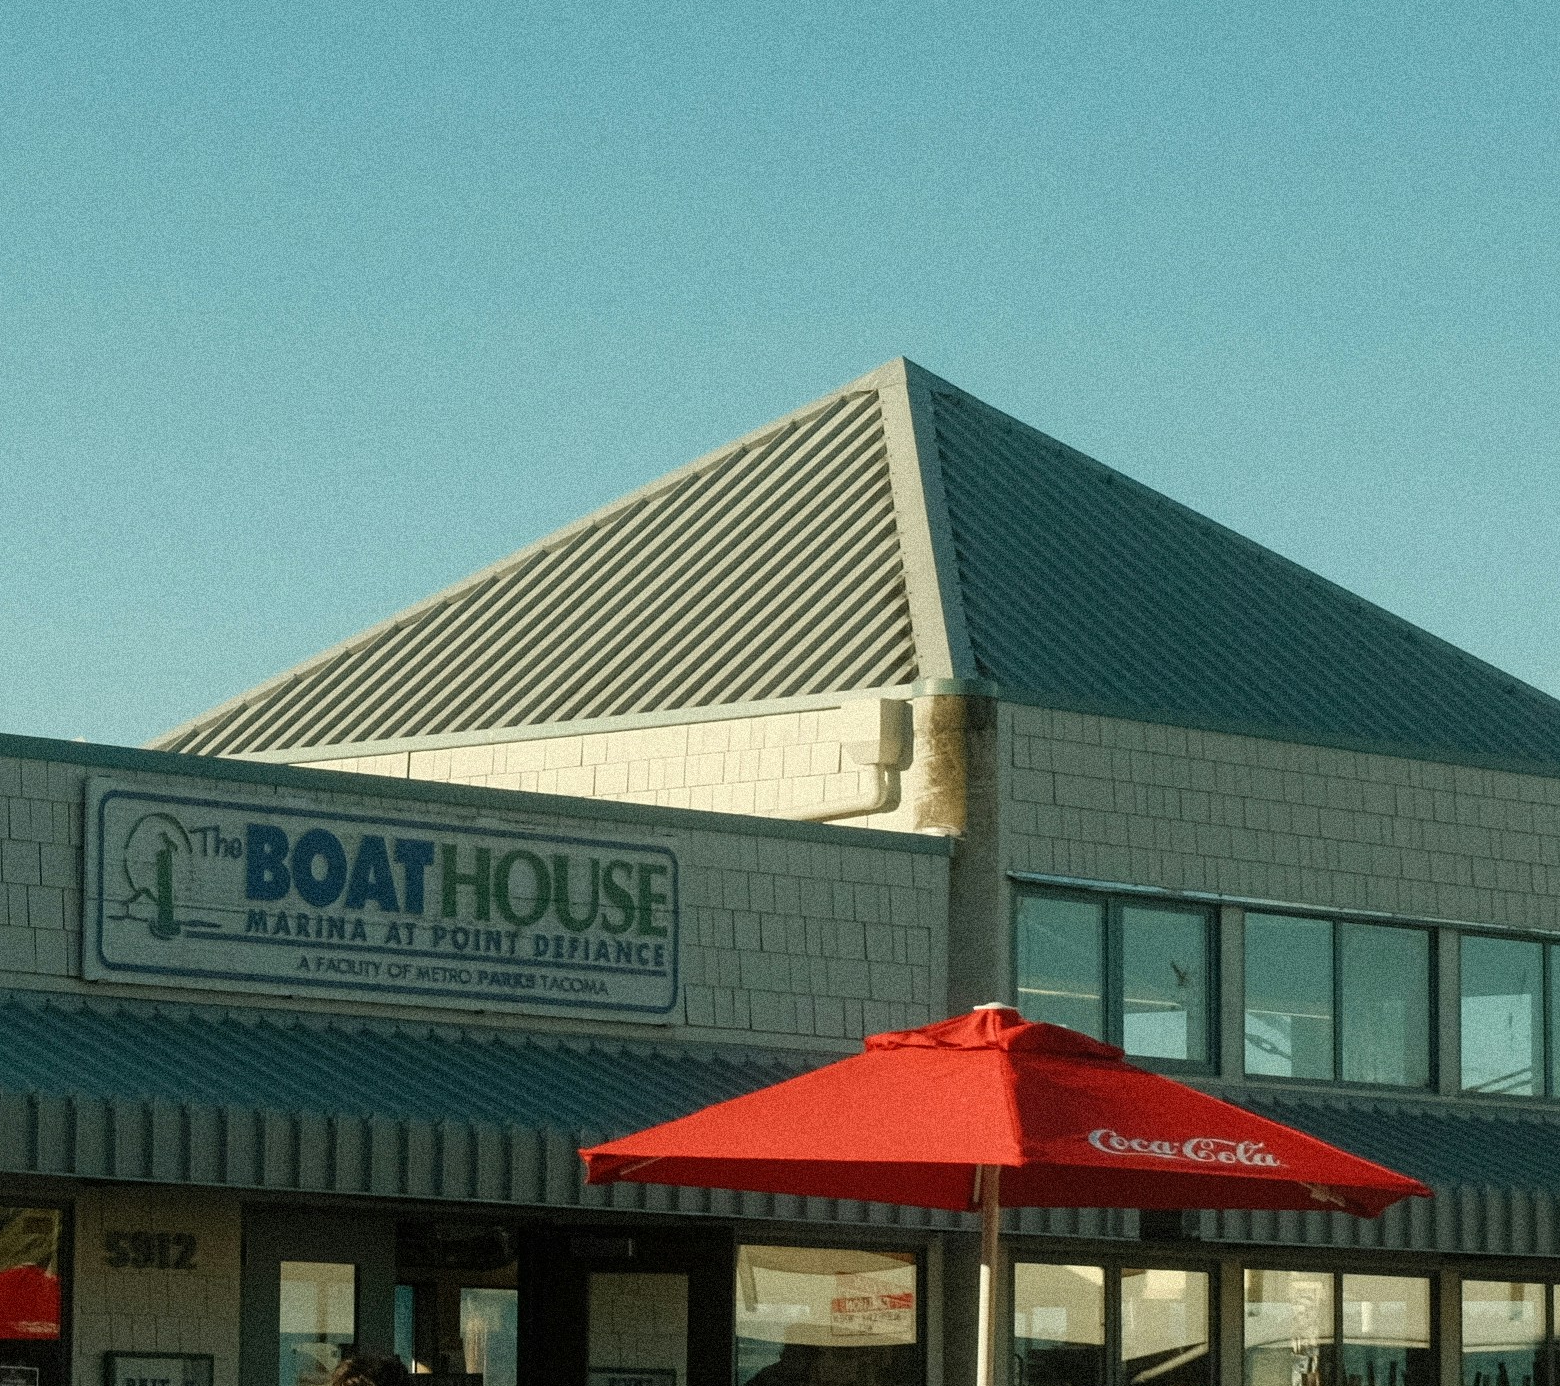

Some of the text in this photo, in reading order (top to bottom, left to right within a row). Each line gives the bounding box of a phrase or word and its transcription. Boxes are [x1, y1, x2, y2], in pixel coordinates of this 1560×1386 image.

[188, 826, 243, 860] The
[245, 910, 666, 969] MARINA AT POINT DEFIANCE
[296, 956, 311, 974] A
[387, 963, 412, 980] OF
[416, 966, 473, 986] METRO
[479, 969, 537, 990] PARKS
[540, 972, 610, 997] TACOMA
[1087, 1128, 1291, 1169] Coca-Cola
[105, 1230, 198, 1271] 5912
